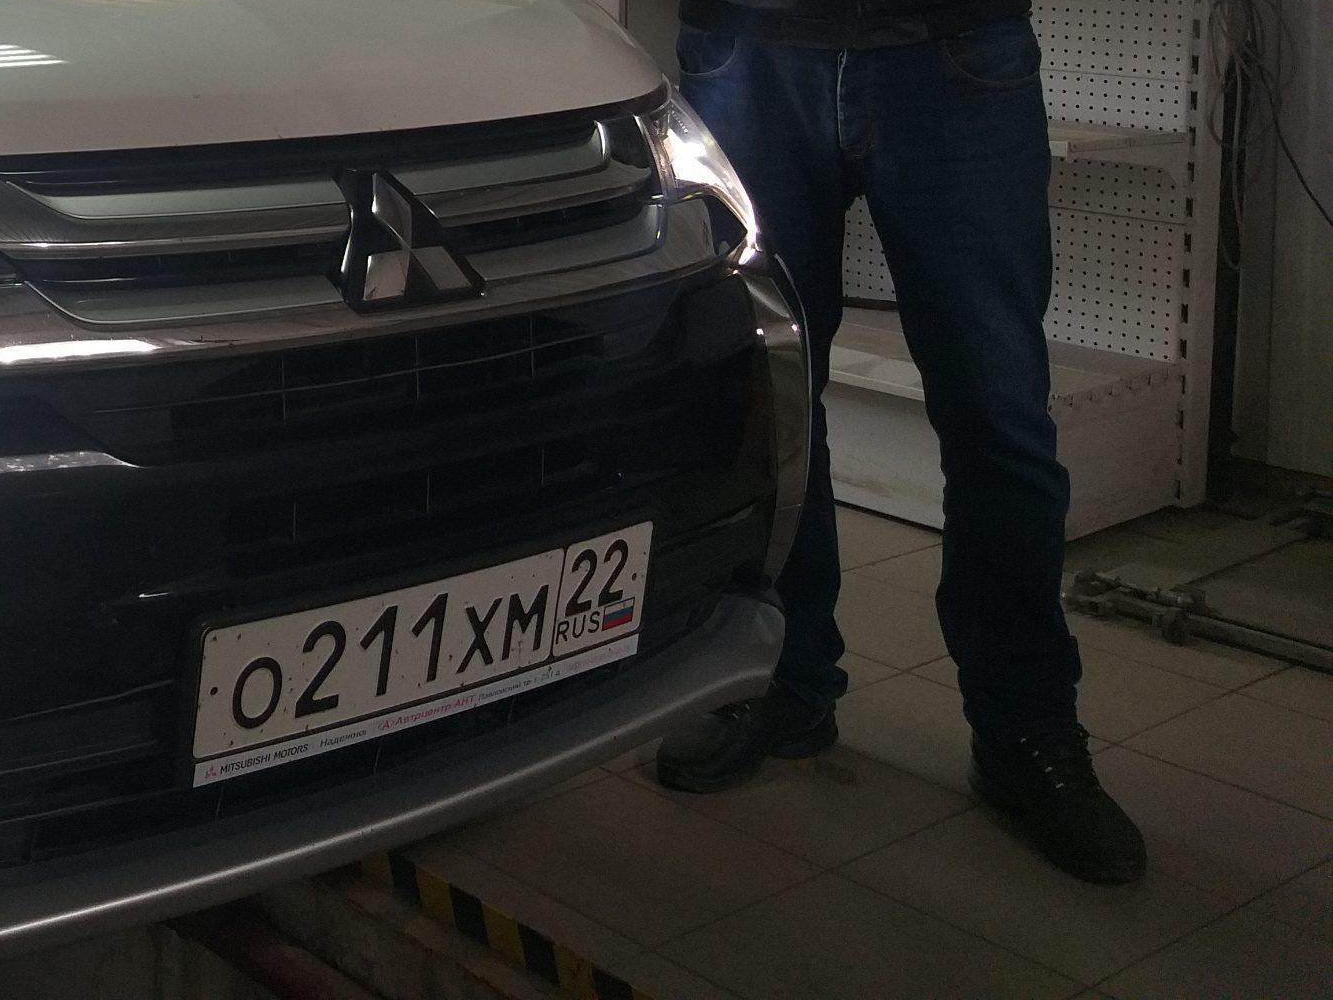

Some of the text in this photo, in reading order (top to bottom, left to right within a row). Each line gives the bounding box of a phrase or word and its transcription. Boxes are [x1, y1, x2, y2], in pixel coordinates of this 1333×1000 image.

[565, 538, 629, 618] 22
[555, 610, 601, 645] RUS
[219, 743, 309, 775] MITSUBISHI MOTORS
